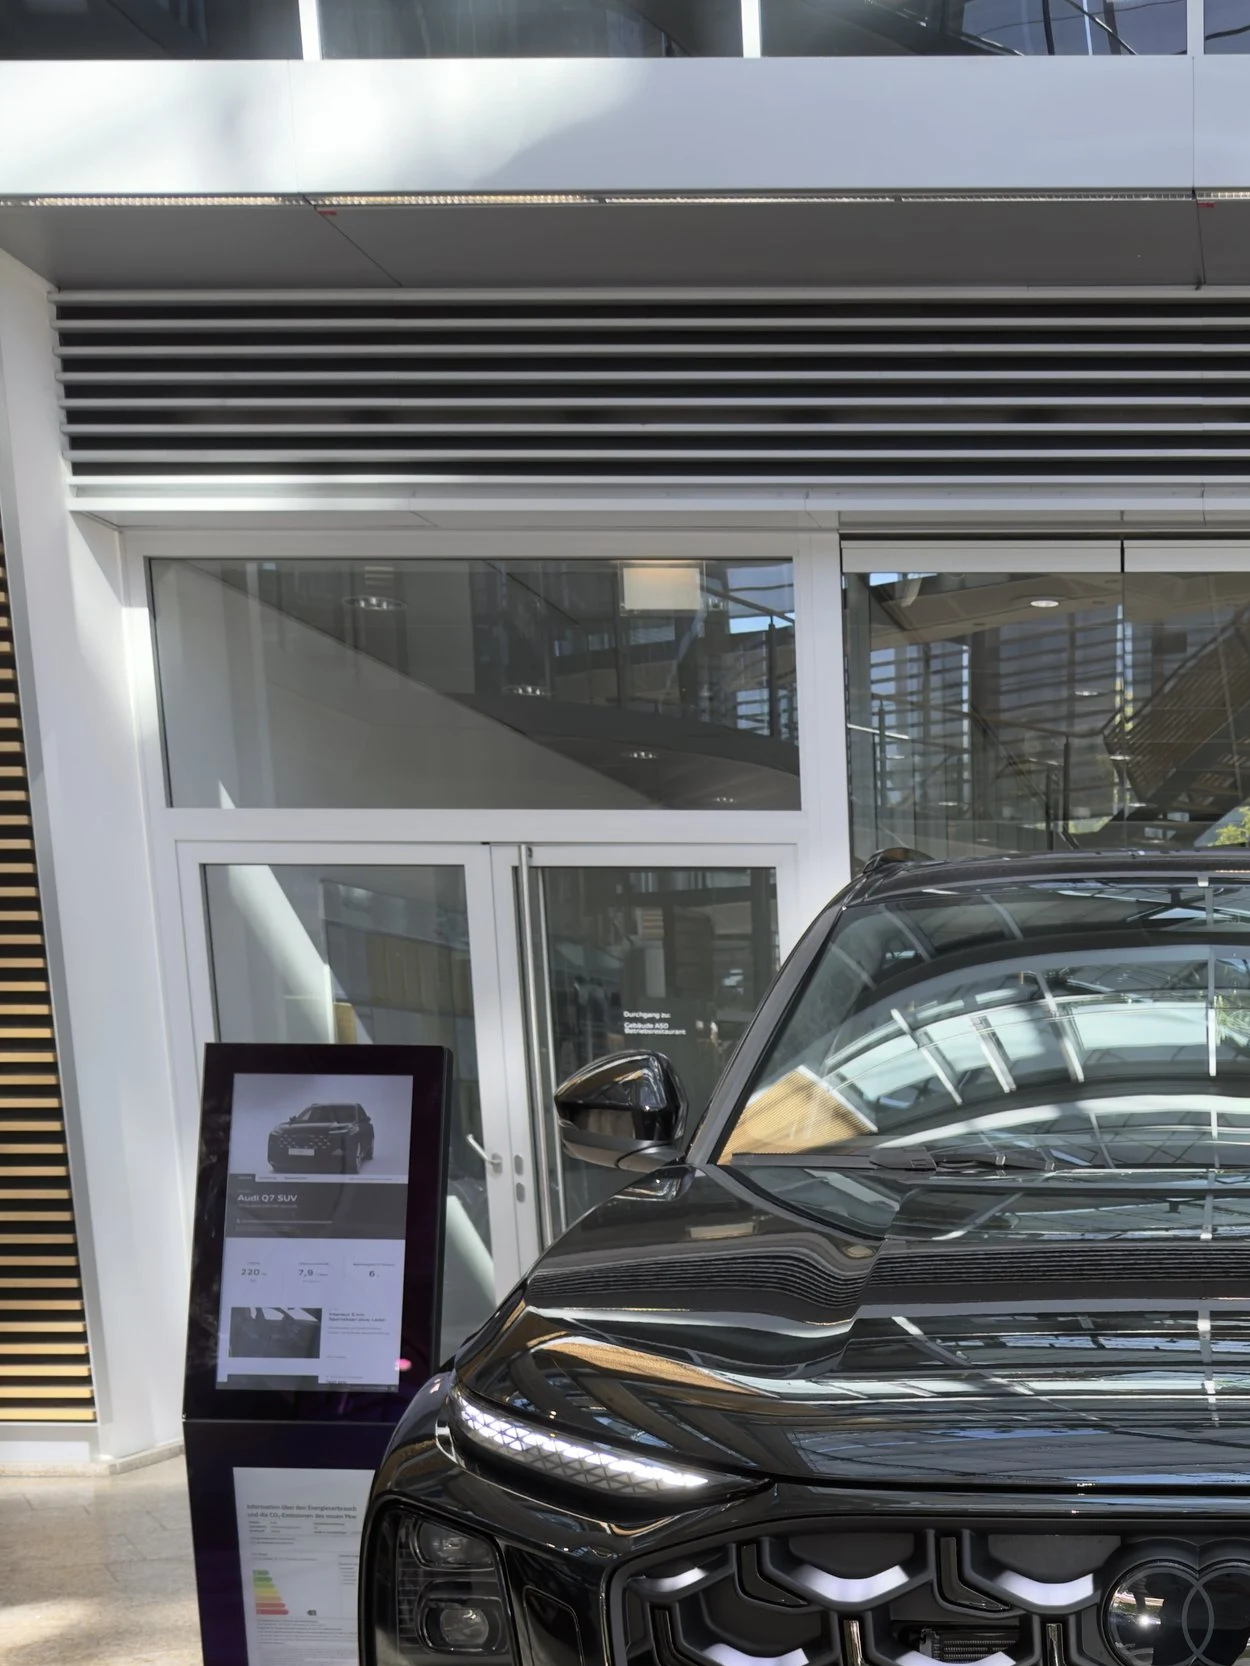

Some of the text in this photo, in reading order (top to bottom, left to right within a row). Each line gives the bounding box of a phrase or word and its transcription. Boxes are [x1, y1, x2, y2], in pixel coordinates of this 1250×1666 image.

[623, 1011, 660, 1019] Durchgang
[624, 1021, 654, 1029] Gebäude
[237, 1194, 298, 1202] Audi Q7 SUV
[298, 1269, 314, 1277] 7,9
[368, 1270, 375, 1278] 6
[246, 1503, 280, 1511] Information
